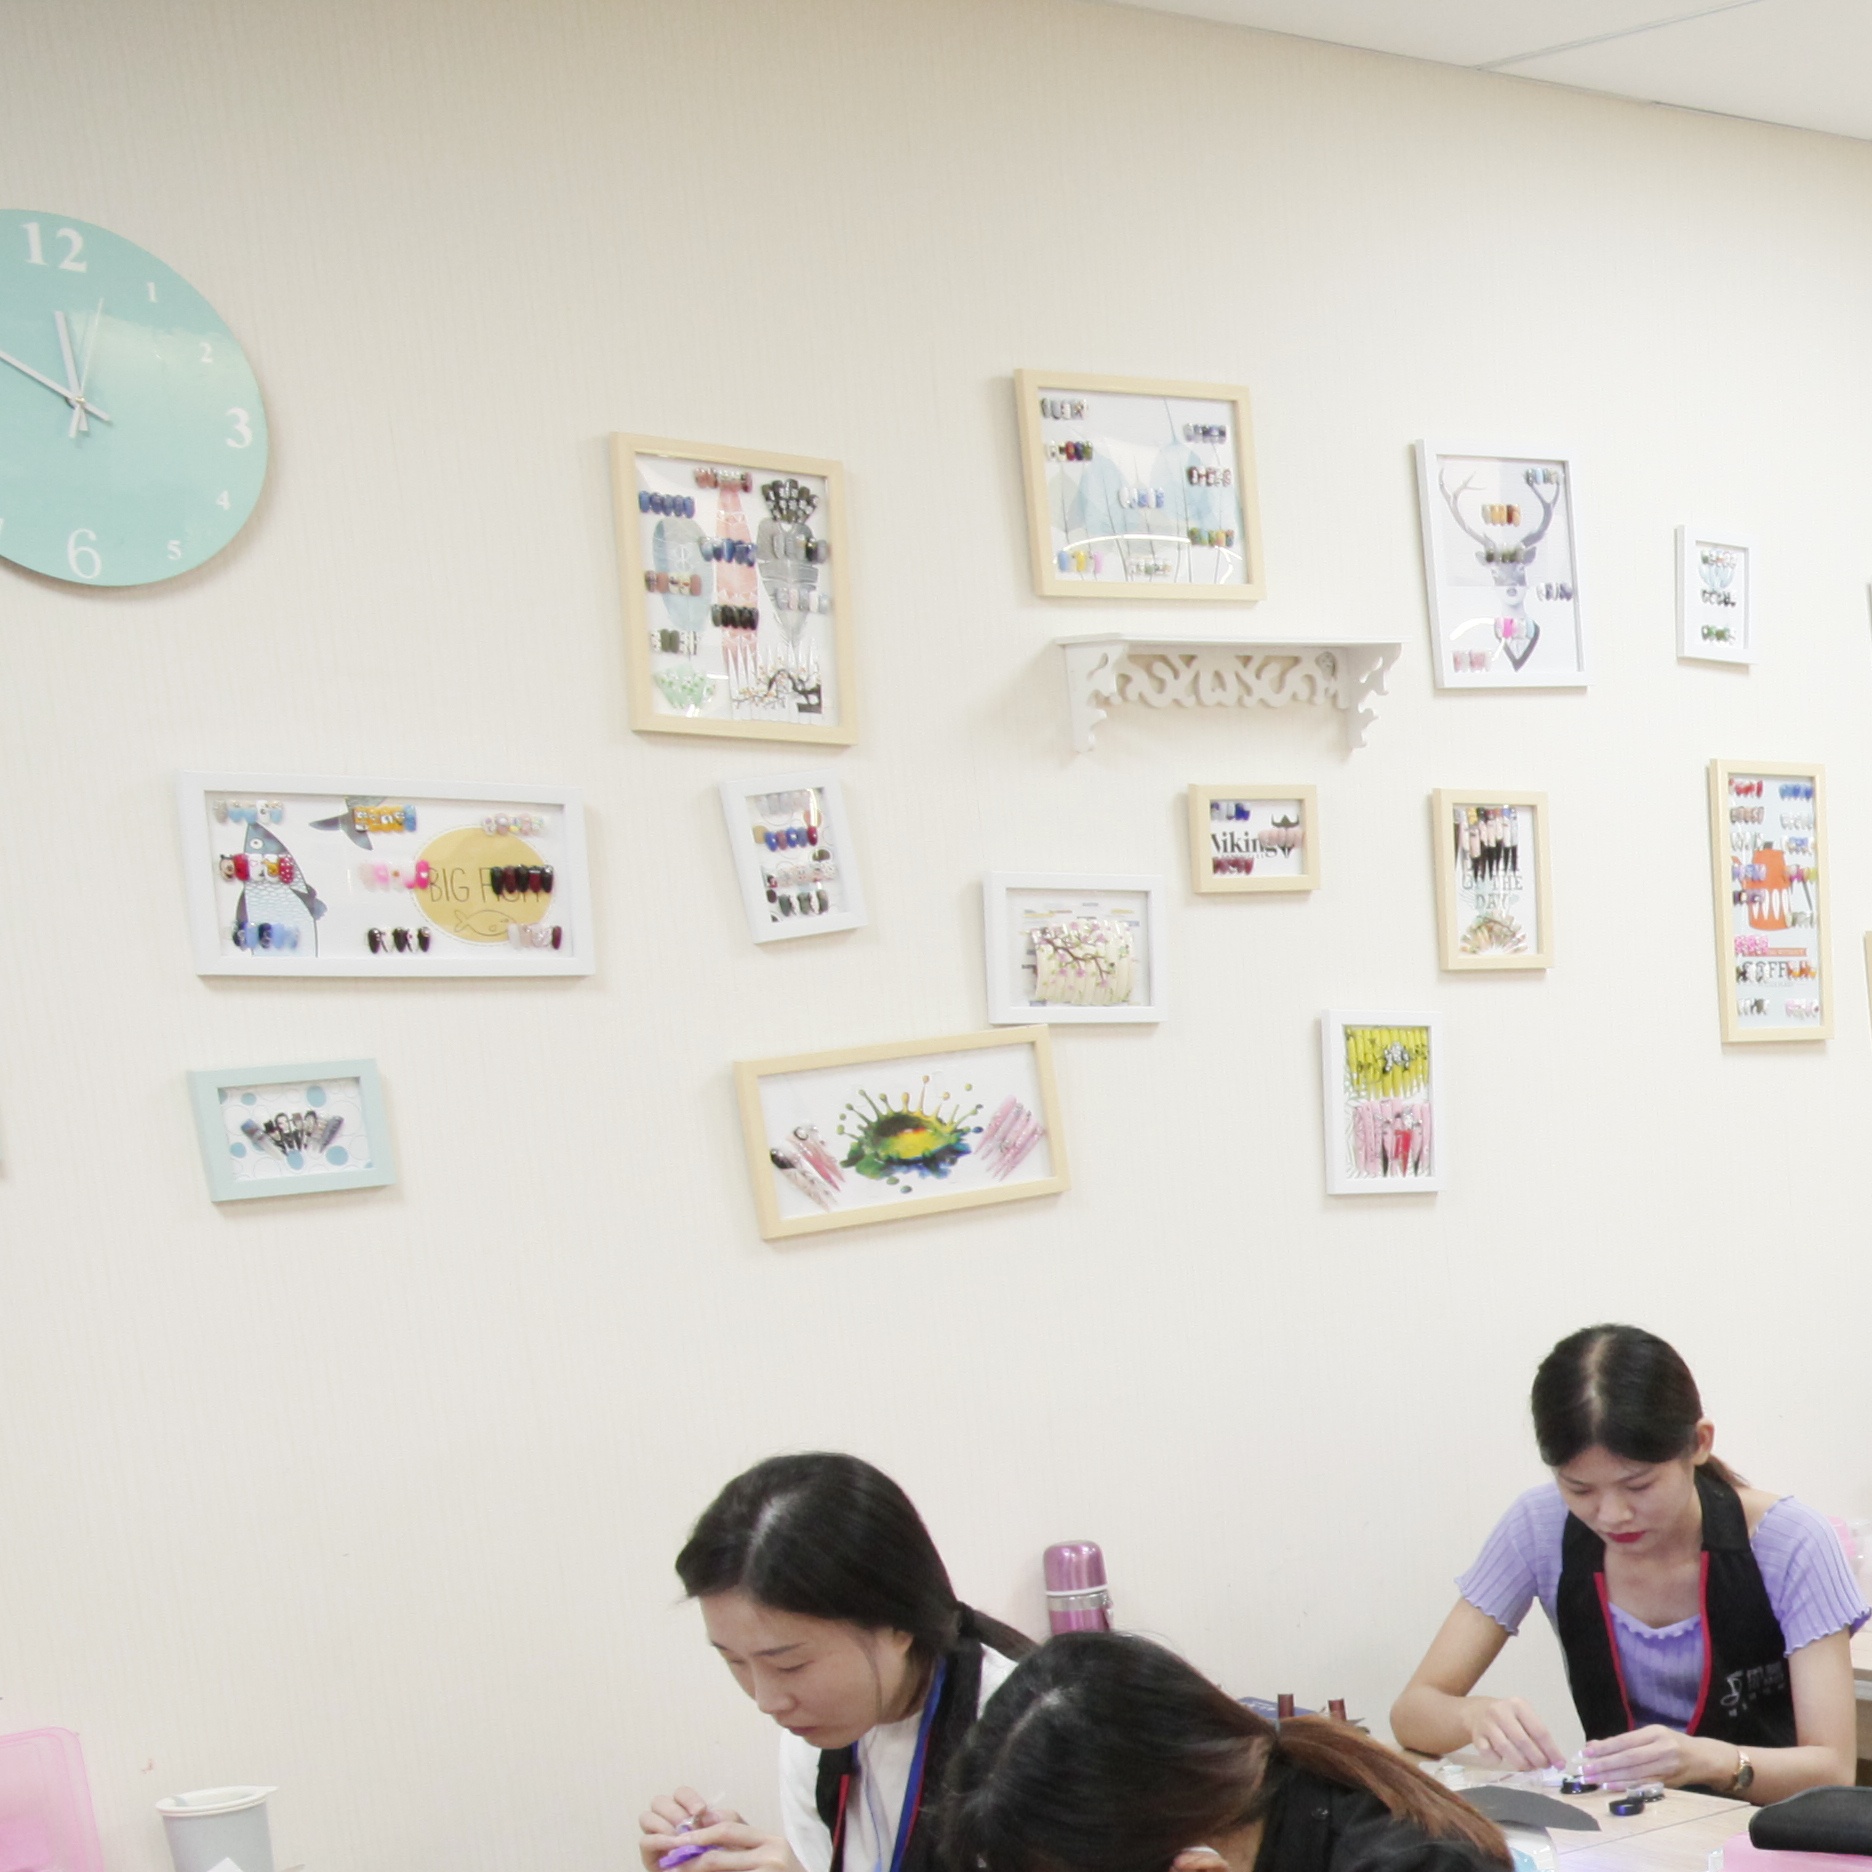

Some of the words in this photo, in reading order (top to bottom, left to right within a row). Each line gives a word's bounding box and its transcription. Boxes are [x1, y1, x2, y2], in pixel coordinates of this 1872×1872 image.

[20, 221, 87, 273] 12
[146, 281, 158, 303] 1
[200, 342, 213, 363] 2
[225, 407, 252, 449] 3
[216, 490, 231, 510] 4
[67, 528, 102, 579] 6
[166, 539, 182, 560] 5
[428, 866, 470, 902] BIG
[1742, 960, 1795, 980] COFF
